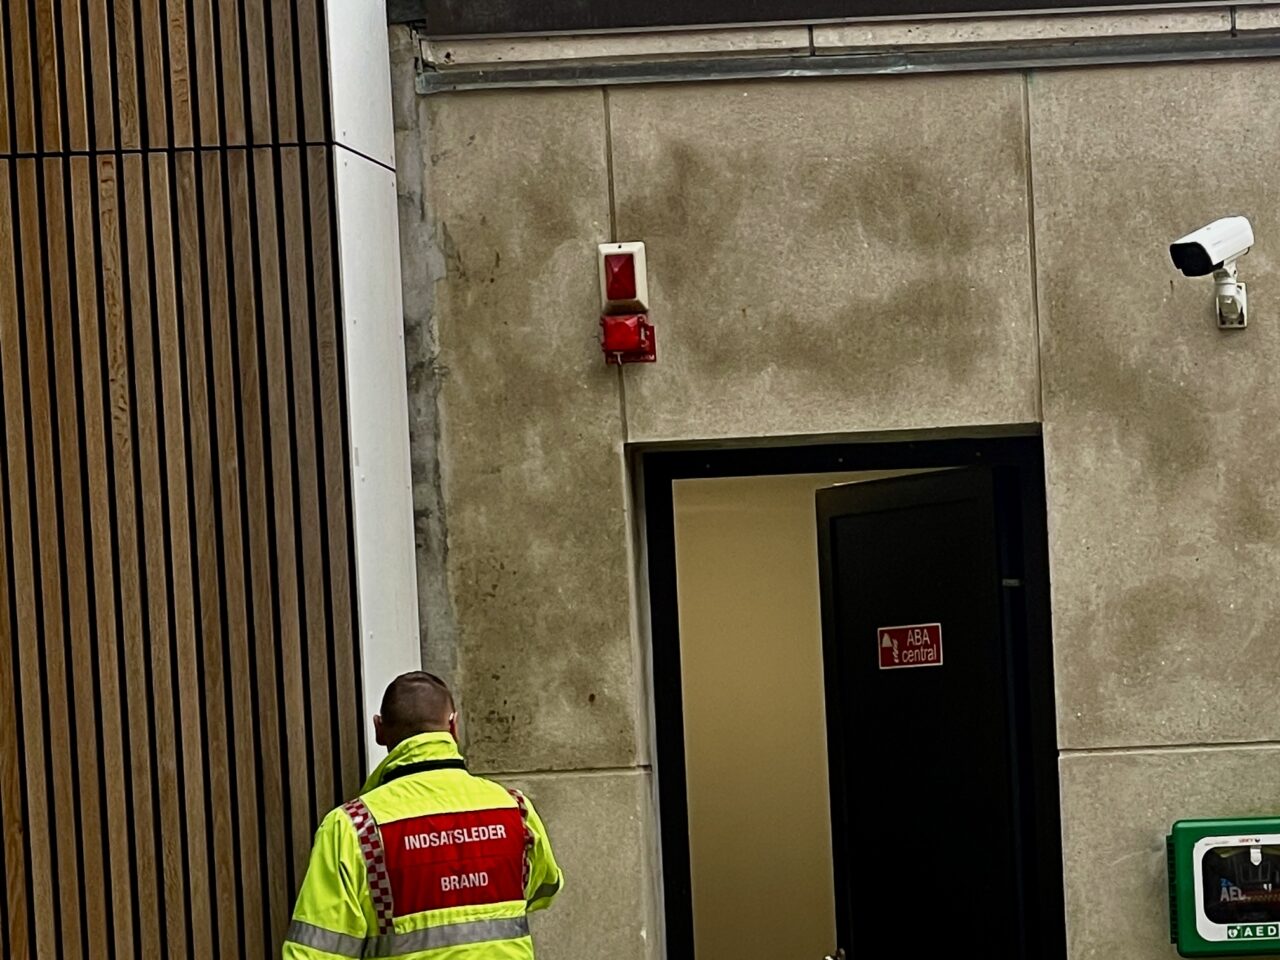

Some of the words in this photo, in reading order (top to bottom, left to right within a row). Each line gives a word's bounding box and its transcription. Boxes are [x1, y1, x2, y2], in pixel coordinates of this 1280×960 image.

[906, 628, 931, 646] ABA
[901, 643, 937, 663] central
[404, 824, 507, 850] INDSATSLEDER
[440, 871, 489, 892] BRAND
[1243, 925, 1278, 937] AED
